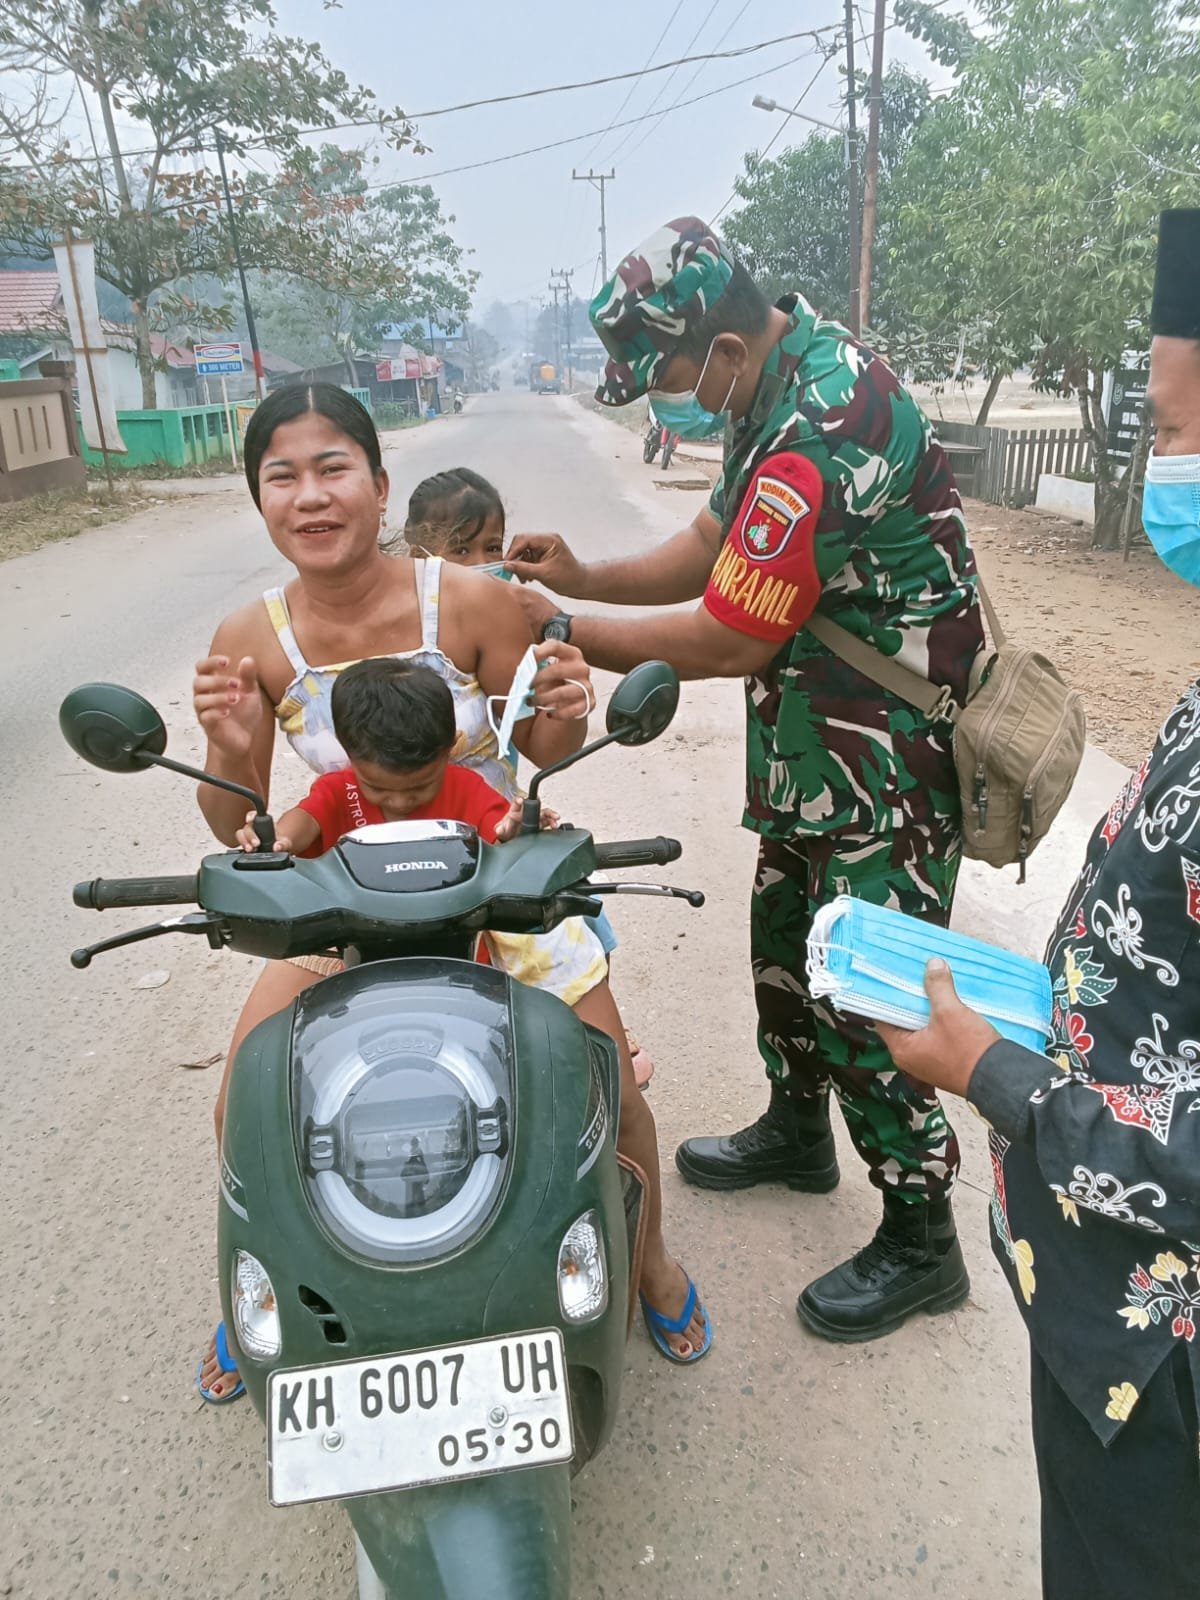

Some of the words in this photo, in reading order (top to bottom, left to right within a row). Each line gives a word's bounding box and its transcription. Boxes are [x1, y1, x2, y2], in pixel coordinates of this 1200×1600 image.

[710, 540, 799, 626] ANRAMIL
[345, 782, 367, 827] ASTRO
[384, 861, 448, 873] HONDA
[279, 1375, 336, 1434] KH
[360, 1354, 464, 1419] 6007
[501, 1340, 557, 1394] UH
